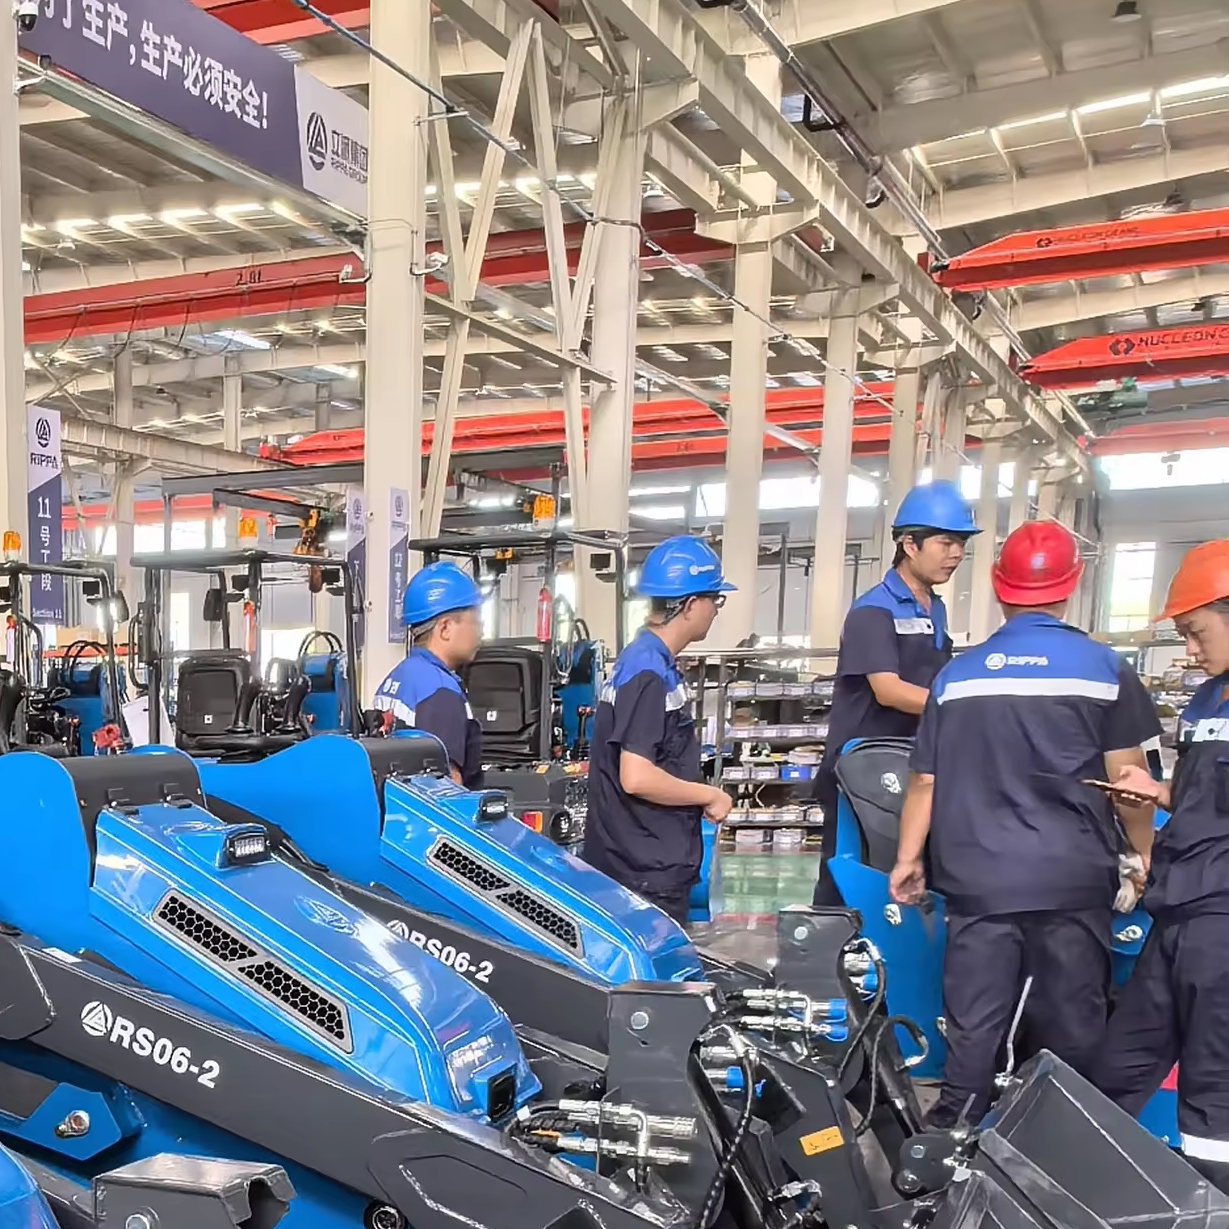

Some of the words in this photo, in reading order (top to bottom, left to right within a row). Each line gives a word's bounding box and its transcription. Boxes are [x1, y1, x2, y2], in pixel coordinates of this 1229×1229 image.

[39, 0, 267, 129] 了生产，生产必须安全！
[410, 930, 493, 983] RS06-2
[110, 1015, 220, 1089] RS06-2
